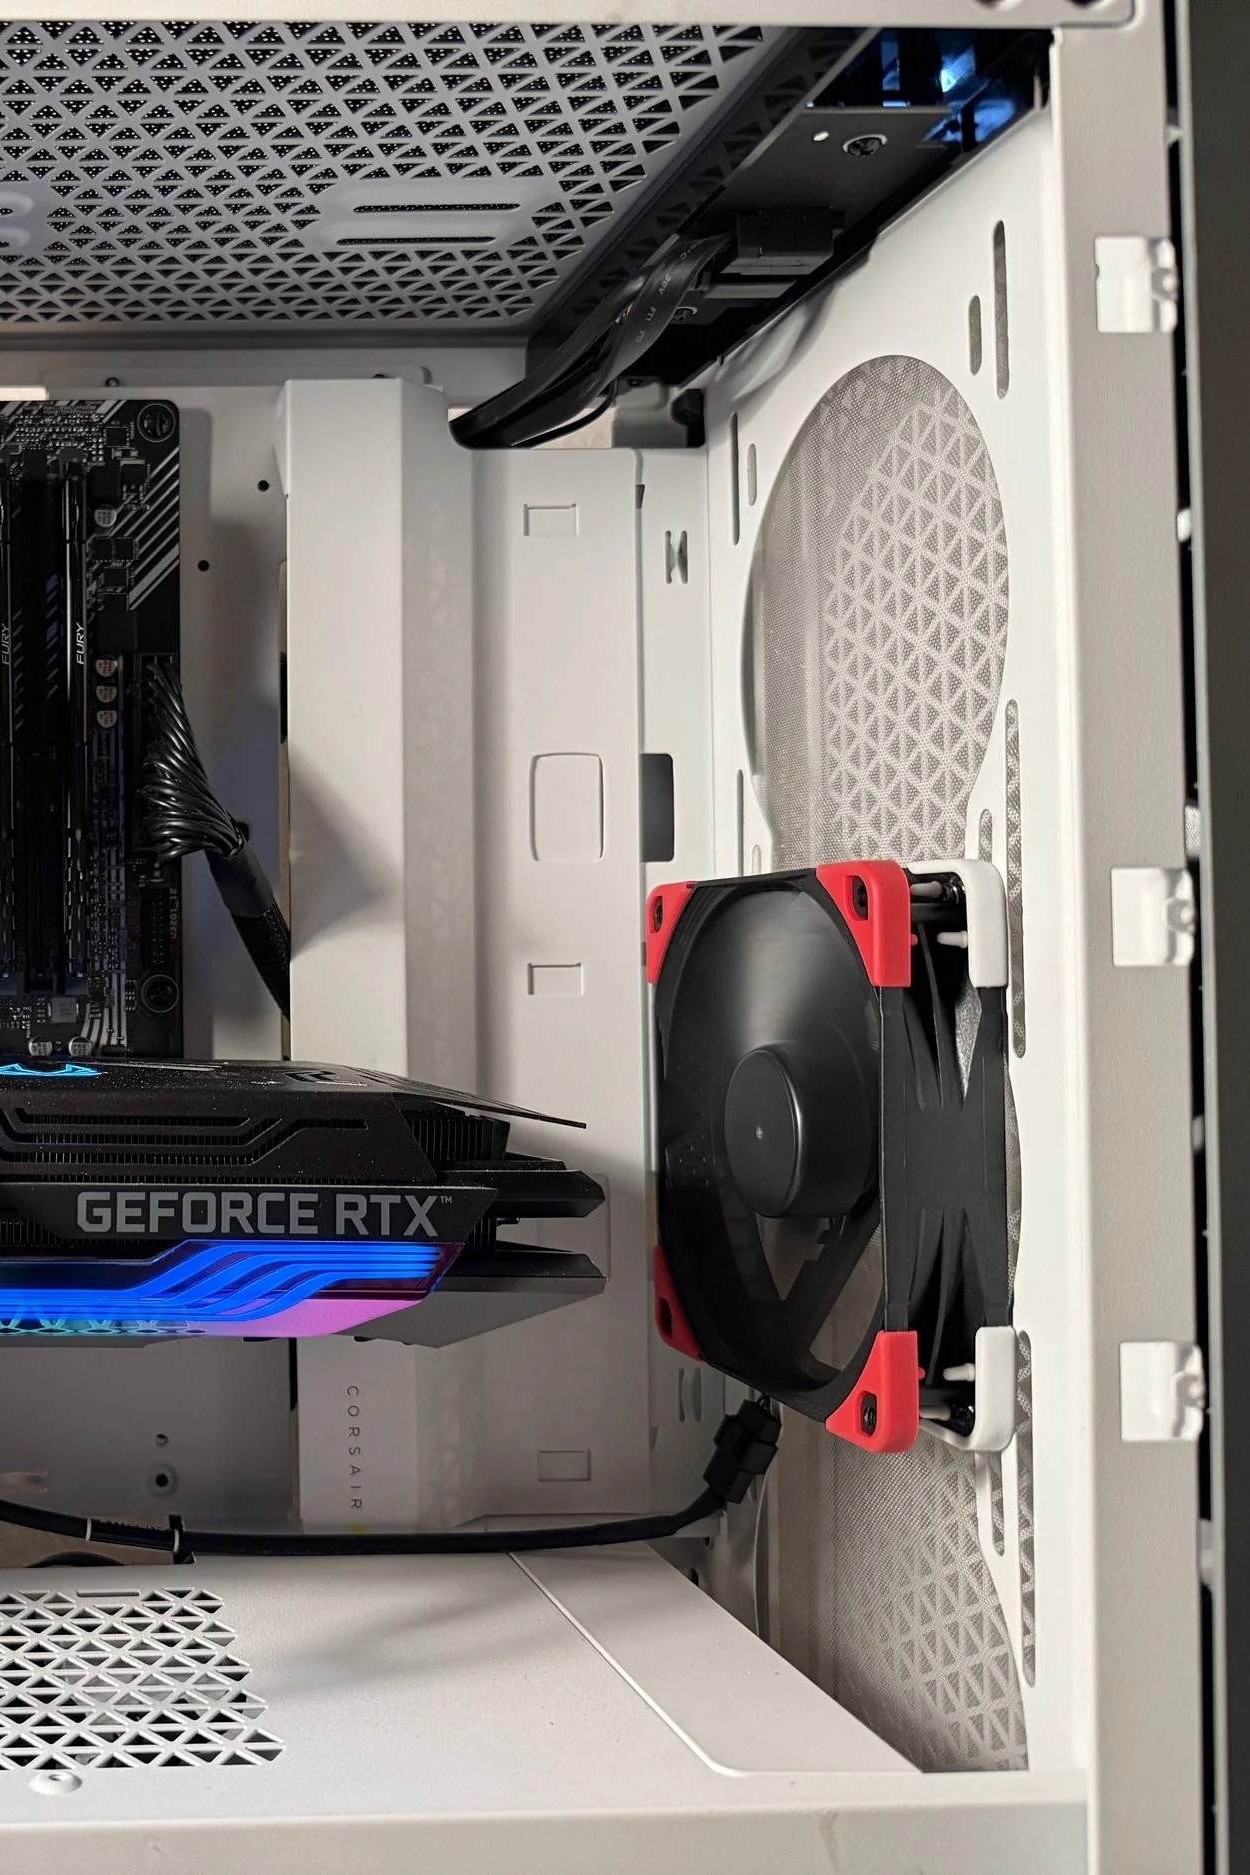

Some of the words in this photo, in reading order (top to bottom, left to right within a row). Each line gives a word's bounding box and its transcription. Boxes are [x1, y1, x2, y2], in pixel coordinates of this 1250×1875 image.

[1, 623, 10, 665] FURY
[76, 622, 85, 665] FURY
[77, 1191, 319, 1234] GEFORCE
[346, 1385, 363, 1510] CORSAIR
